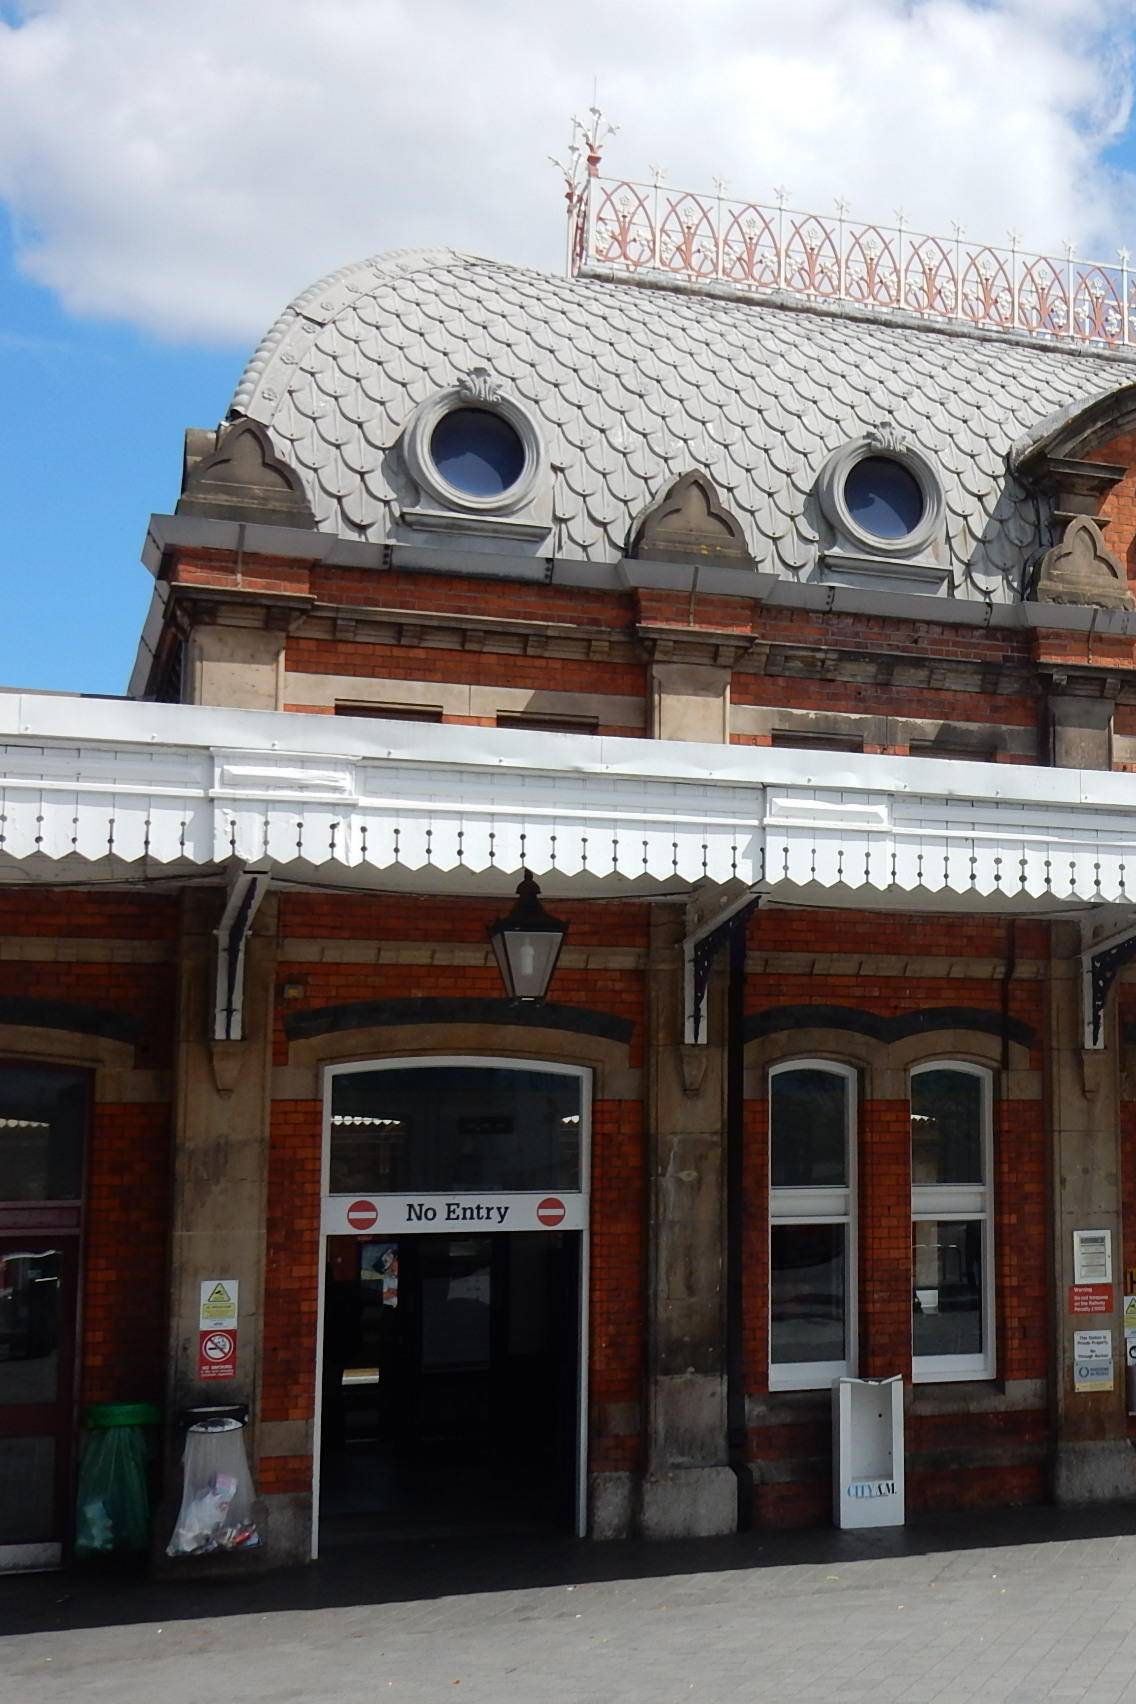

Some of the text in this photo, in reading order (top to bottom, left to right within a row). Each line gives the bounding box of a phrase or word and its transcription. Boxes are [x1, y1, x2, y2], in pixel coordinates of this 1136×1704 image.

[406, 1202, 509, 1224] No Entry
[847, 1483, 873, 1497] CITY
